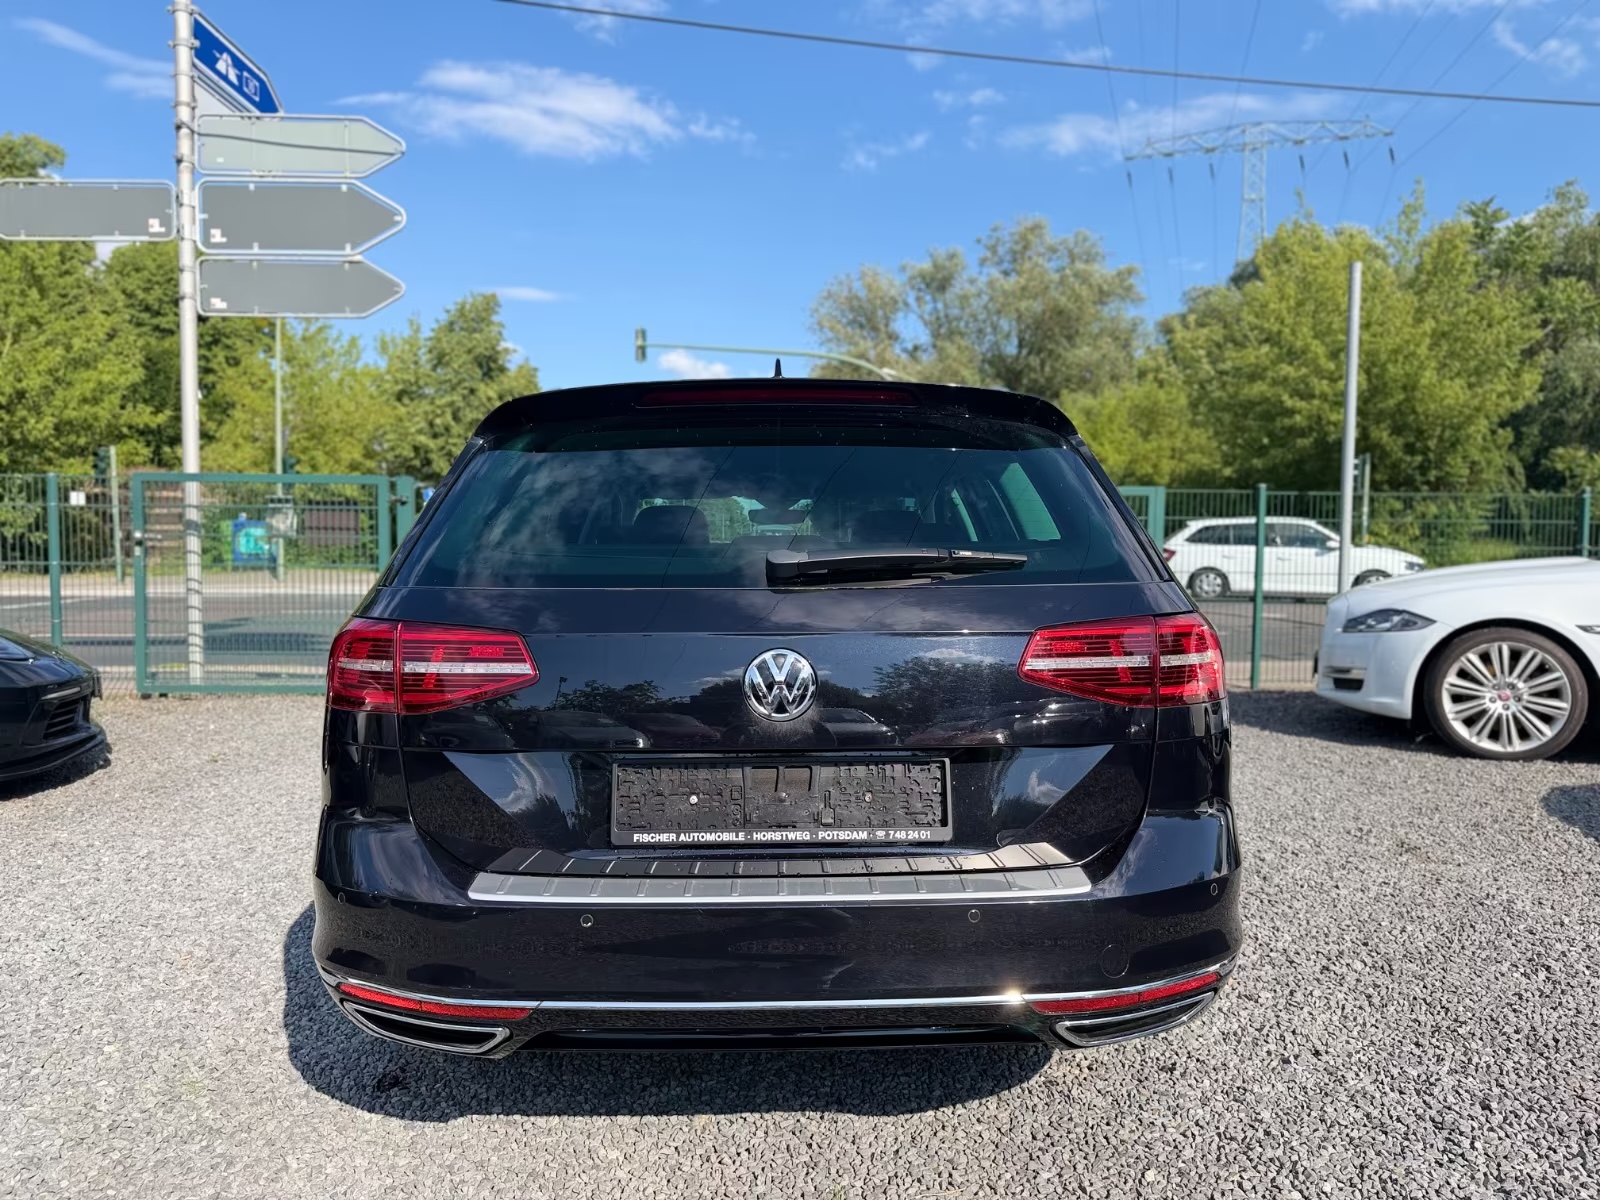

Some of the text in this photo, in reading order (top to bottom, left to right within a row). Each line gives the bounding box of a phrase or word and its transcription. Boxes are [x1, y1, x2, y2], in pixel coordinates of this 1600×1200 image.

[745, 648, 817, 720] VW
[633, 832, 677, 843] FISCHER
[678, 832, 746, 842] AUTOMOBILE
[752, 831, 811, 841] HORSTWEG
[818, 831, 868, 840] POTSDAM
